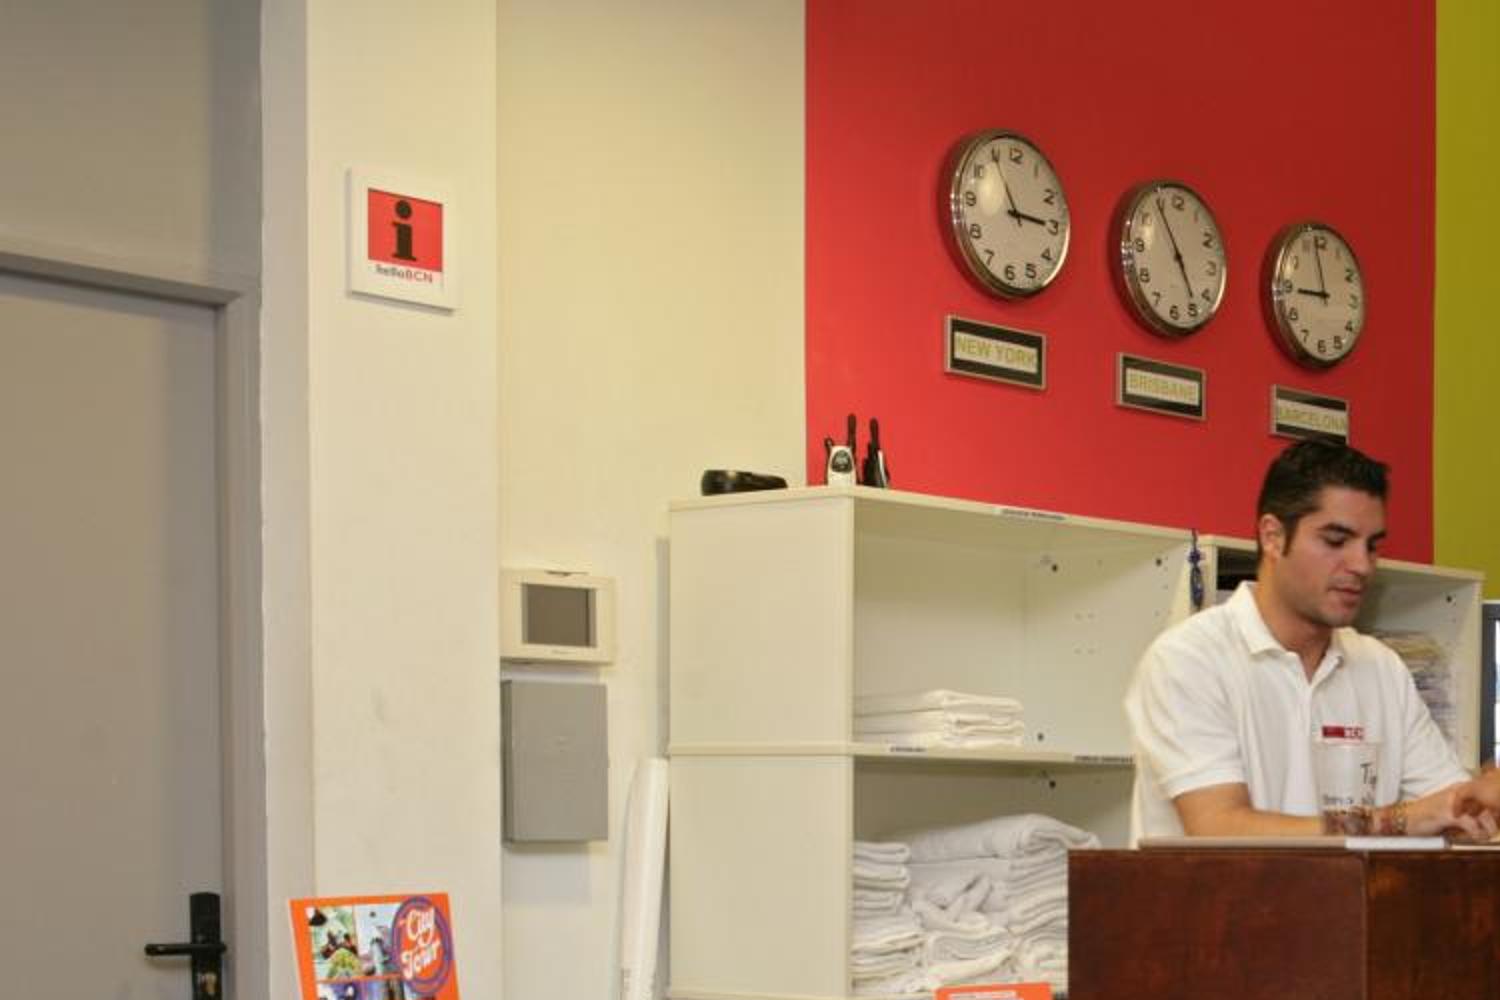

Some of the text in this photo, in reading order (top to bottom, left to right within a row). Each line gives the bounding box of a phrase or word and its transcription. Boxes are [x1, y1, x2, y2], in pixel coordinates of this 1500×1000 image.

[1010, 148, 1023, 164] 12
[966, 191, 976, 206] 9
[1044, 189, 1055, 205] 2
[970, 224, 981, 238] 8
[1048, 220, 1058, 235] 3
[1135, 238, 1144, 252] 9
[1203, 232, 1212, 248] 2
[984, 249, 994, 265] 7
[1041, 249, 1053, 261] 4
[1005, 266, 1015, 280] 6
[1025, 264, 1036, 278] 5
[1140, 268, 1150, 283] 8
[1206, 262, 1216, 276] 3
[1345, 269, 1353, 283] 2
[1283, 280, 1293, 293] 9
[1152, 292, 1160, 305] 7
[1170, 305, 1179, 319] 6
[1188, 304, 1197, 317] 5
[1301, 330, 1309, 343] 7
[957, 335, 992, 357] NEW
[405, 907, 436, 948] City
[401, 941, 441, 980] Tour
